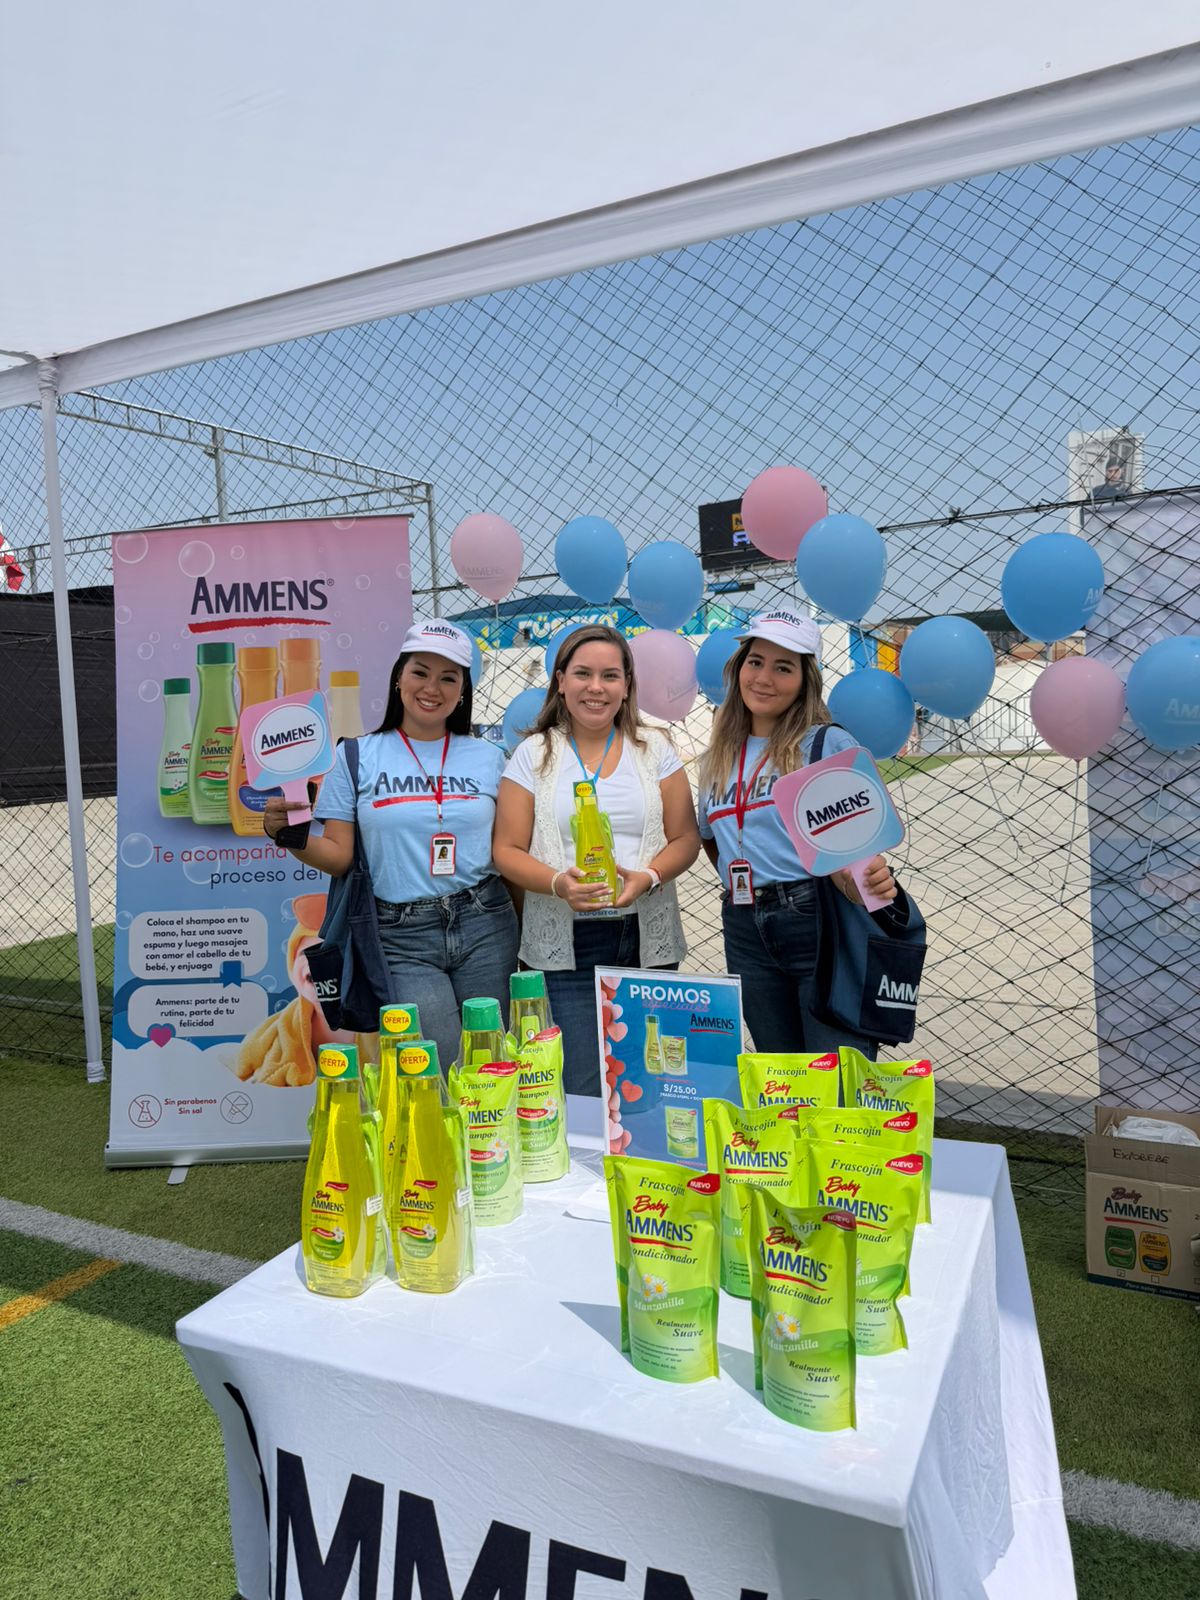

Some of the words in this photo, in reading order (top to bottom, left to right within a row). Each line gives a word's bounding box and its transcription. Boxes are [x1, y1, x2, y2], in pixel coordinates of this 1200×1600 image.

[190, 577, 328, 615] AMMENS
[422, 625, 458, 640] AMMENS
[260, 726, 314, 750] AMMENS
[374, 772, 480, 796] AMMENS
[805, 792, 870, 829] AMMENS
[154, 846, 174, 864] Te
[180, 842, 288, 866] acompaña
[210, 870, 286, 890] proceso
[293, 863, 322, 881] del
[147, 918, 174, 926] Coloca
[176, 917, 183, 925] el
[186, 916, 225, 926] shampoo
[240, 916, 250, 924] tu
[153, 930, 178, 938] mano,
[181, 928, 196, 937] haz
[217, 928, 243, 936] suave
[144, 942, 175, 950] espuma
[177, 941, 182, 950] y
[185, 940, 209, 949] luego
[211, 939, 248, 948] masajea
[186, 950, 194, 958] el
[196, 949, 227, 958] cabello
[229, 949, 239, 957] de
[145, 963, 168, 972] bebé,
[170, 964, 175, 972] y
[177, 962, 212, 972] enjuaga
[155, 998, 193, 1006] Ammens:
[194, 997, 217, 1005] parte
[218, 996, 229, 1004] de
[629, 984, 711, 1004] PROMOS
[189, 1009, 212, 1017] parte
[384, 1016, 409, 1024] OFERTA
[179, 1019, 214, 1028] felicidad
[690, 1013, 734, 1030] AMMENS
[320, 1056, 346, 1068] OFERTA
[400, 1056, 428, 1064] OFERTA
[518, 1069, 554, 1084] MENS
[767, 1066, 808, 1078] Frascojín
[907, 1066, 926, 1074] NUEVO
[463, 1081, 497, 1092] Frascojín
[663, 1084, 697, 1095] S/25.00
[764, 1080, 792, 1096] Baby
[164, 1098, 175, 1106] Sin
[177, 1098, 217, 1106] parabenos
[519, 1090, 549, 1099] hampoo
[856, 1088, 910, 1112] AMMENS
[468, 1109, 502, 1124] MENS
[735, 1118, 776, 1133] Frascojín
[834, 1124, 882, 1137] Frascojín
[888, 1119, 910, 1127] NUEVO
[469, 1131, 497, 1140] ampoo
[731, 1132, 760, 1152] Baby
[723, 1144, 788, 1168] AMMENS
[831, 1159, 883, 1176] Frascojín
[890, 1160, 914, 1168] NUEVO
[639, 1176, 685, 1196] Frascojín
[690, 1180, 711, 1189] NUEVO
[726, 1176, 792, 1188] condicionador
[825, 1176, 861, 1198] Baby
[316, 1190, 330, 1200] Baby
[404, 1189, 419, 1199] Baby
[1111, 1186, 1142, 1204] Baby
[312, 1197, 344, 1212] AMMENS
[400, 1196, 434, 1210] AMMENS
[633, 1195, 670, 1218] Baby
[817, 1190, 890, 1223] AMMENS
[1104, 1197, 1168, 1222] AMMENS
[626, 1209, 693, 1242] AMMENS
[766, 1226, 802, 1252] Baby
[632, 1248, 698, 1265] ondicionador
[760, 1243, 828, 1283] AMMENS
[856, 1275, 878, 1287] nilla
[767, 1284, 833, 1306] ondicionador
[656, 1318, 696, 1328] Realmente
[672, 1327, 704, 1338] Suave
[789, 1360, 831, 1373] Realmente
[806, 1372, 840, 1384] Suave
